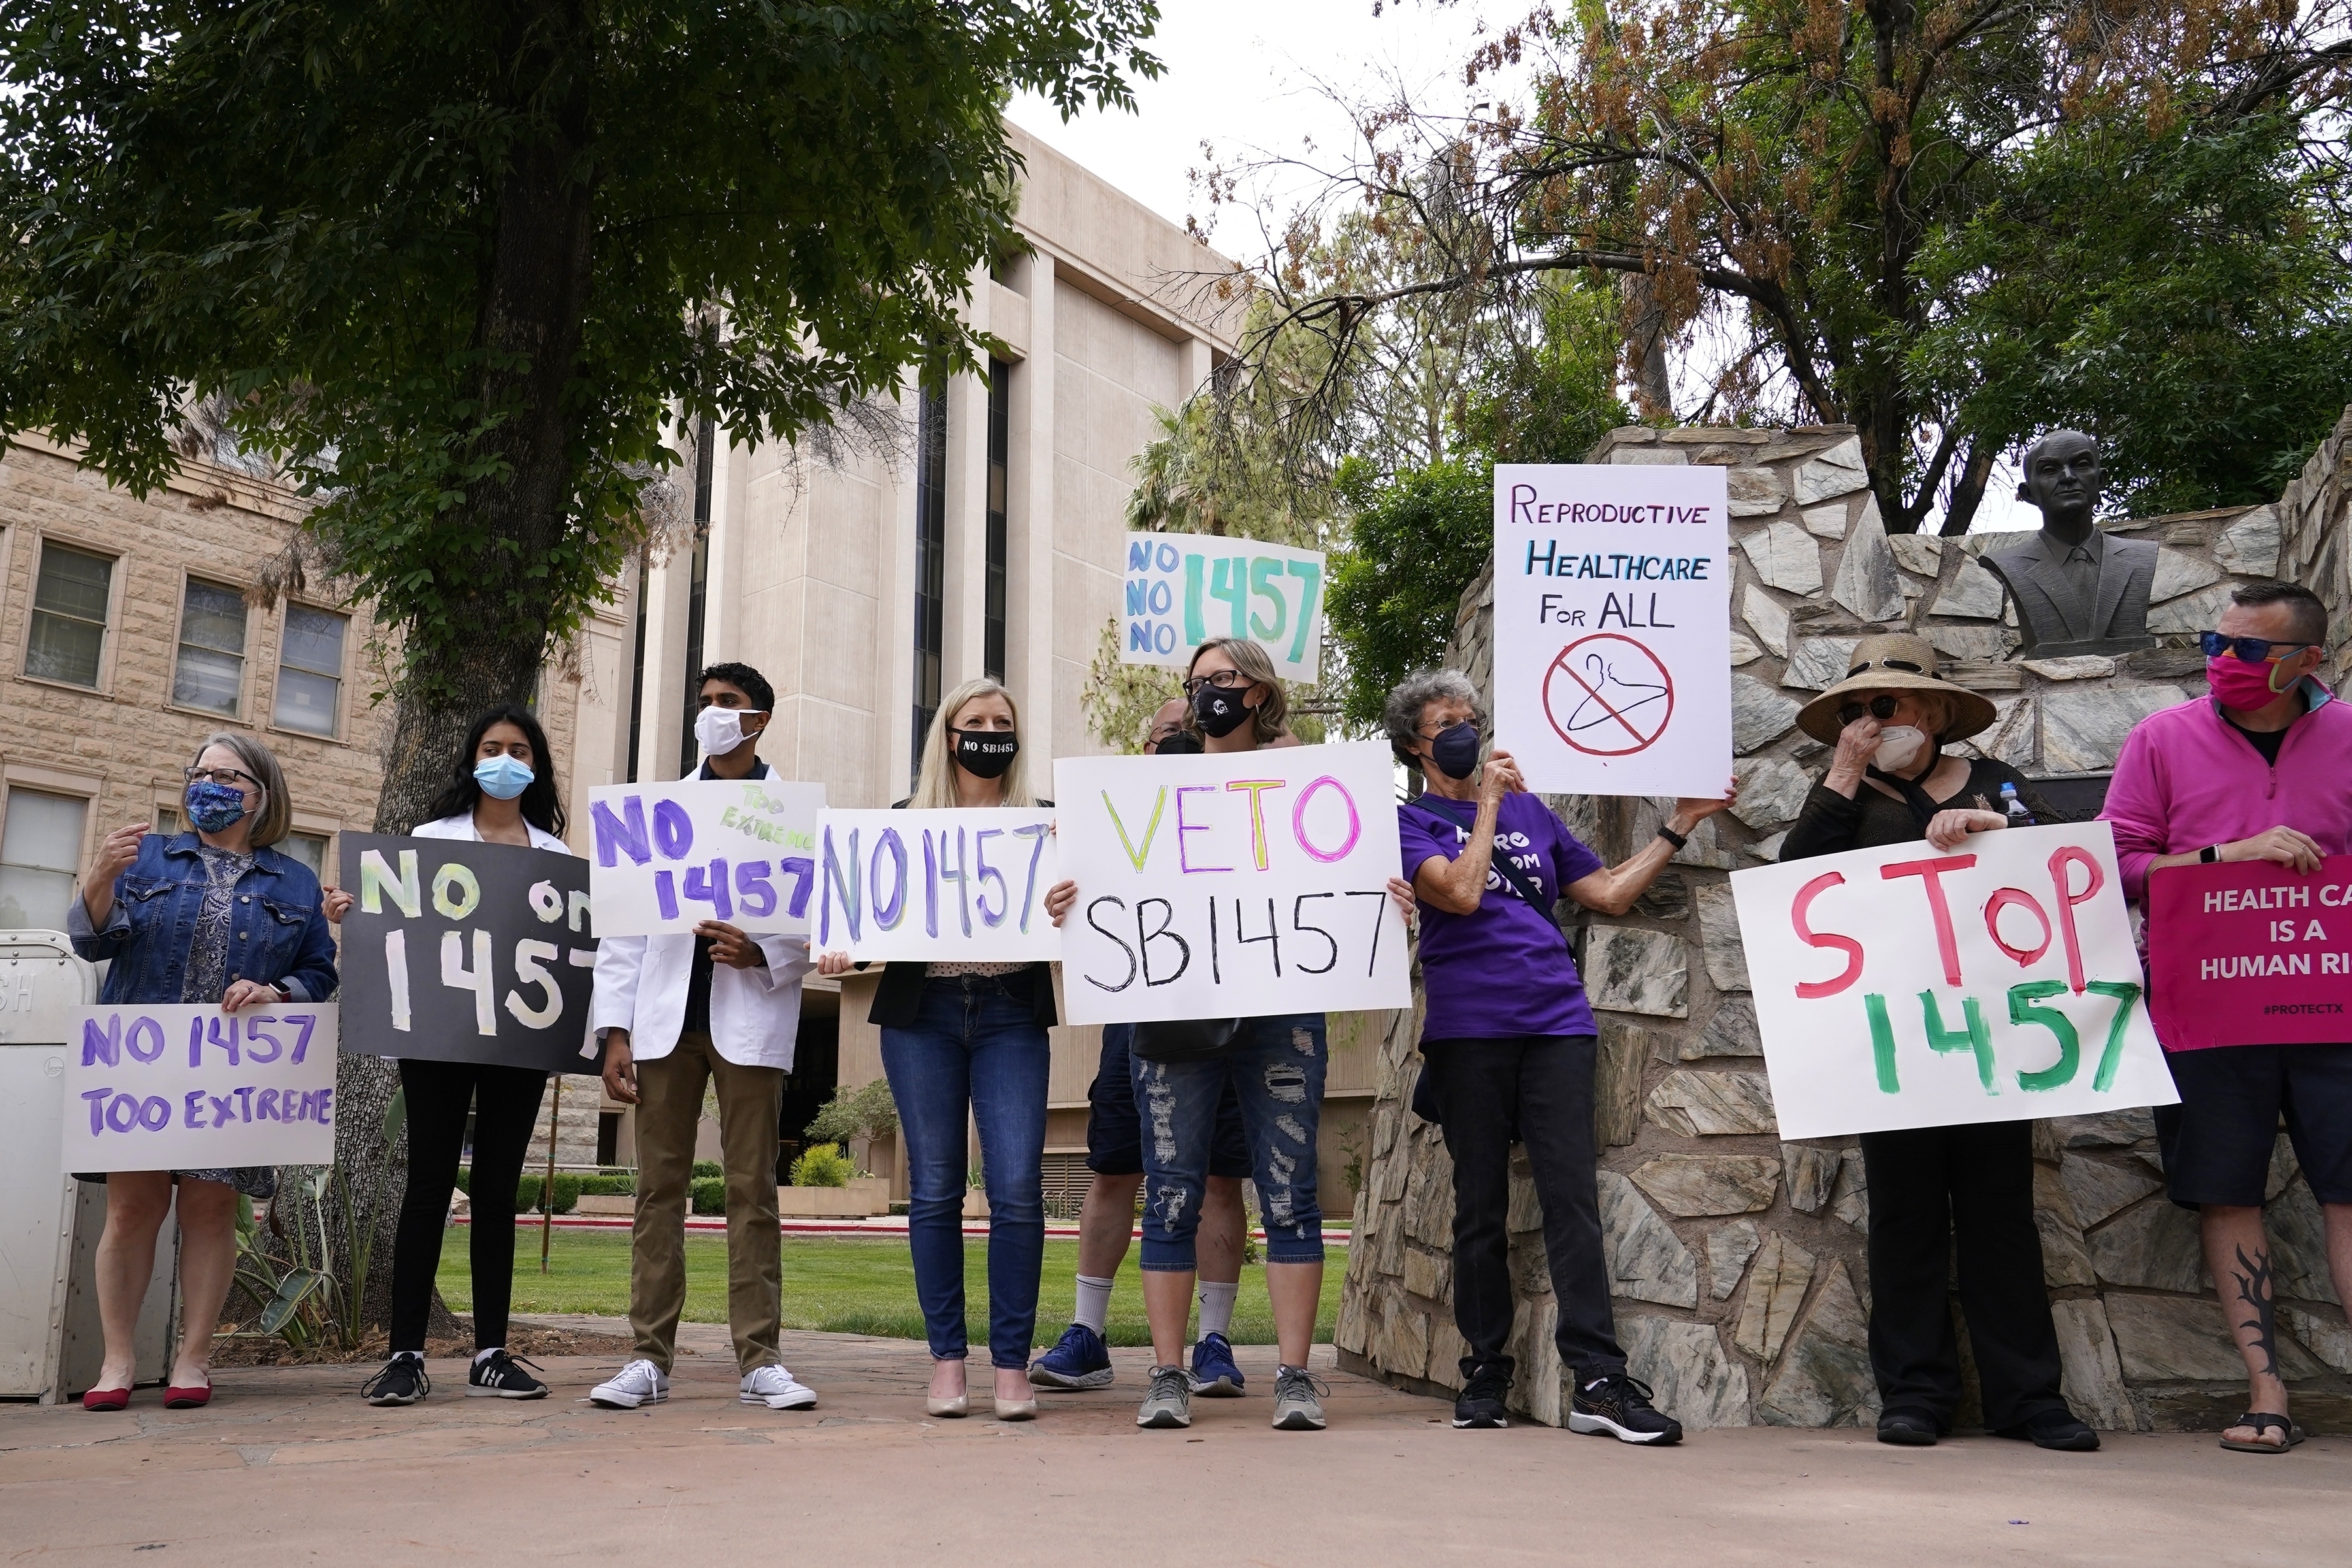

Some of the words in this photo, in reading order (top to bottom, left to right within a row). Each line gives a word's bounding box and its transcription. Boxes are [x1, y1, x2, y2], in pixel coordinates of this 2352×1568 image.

[1511, 484, 1711, 525] REPRODUCTIVE
[1129, 540, 1180, 574] NO
[1524, 539, 1712, 581] HEALTHCARE
[1126, 578, 1173, 616] NO
[1184, 554, 1321, 663] 1457
[1598, 592, 1675, 630] ALL
[1130, 620, 1177, 656] NO
[963, 741, 977, 751] NO
[983, 743, 1013, 753] SB1457
[591, 795, 694, 868] NO
[1102, 775, 1362, 875] VETO
[361, 849, 481, 921] NO
[655, 857, 814, 921] 1457
[820, 824, 908, 947] NO
[923, 824, 1049, 938] 1457
[2204, 886, 2309, 913] HEALTH
[1085, 891, 1386, 992] SB1457
[1791, 845, 2104, 998] STOP
[2270, 920, 2295, 942] IS
[2303, 919, 2327, 941] A
[2201, 954, 2310, 980] HUMAN
[2321, 953, 2352, 974] RI
[2263, 1004, 2344, 1015] #PROTECTX
[81, 1013, 165, 1068] NO
[189, 1015, 317, 1068] 1457
[1865, 979, 2142, 1096] 1457
[81, 1087, 172, 1137] TOO
[184, 1086, 333, 1129] EXTREME
